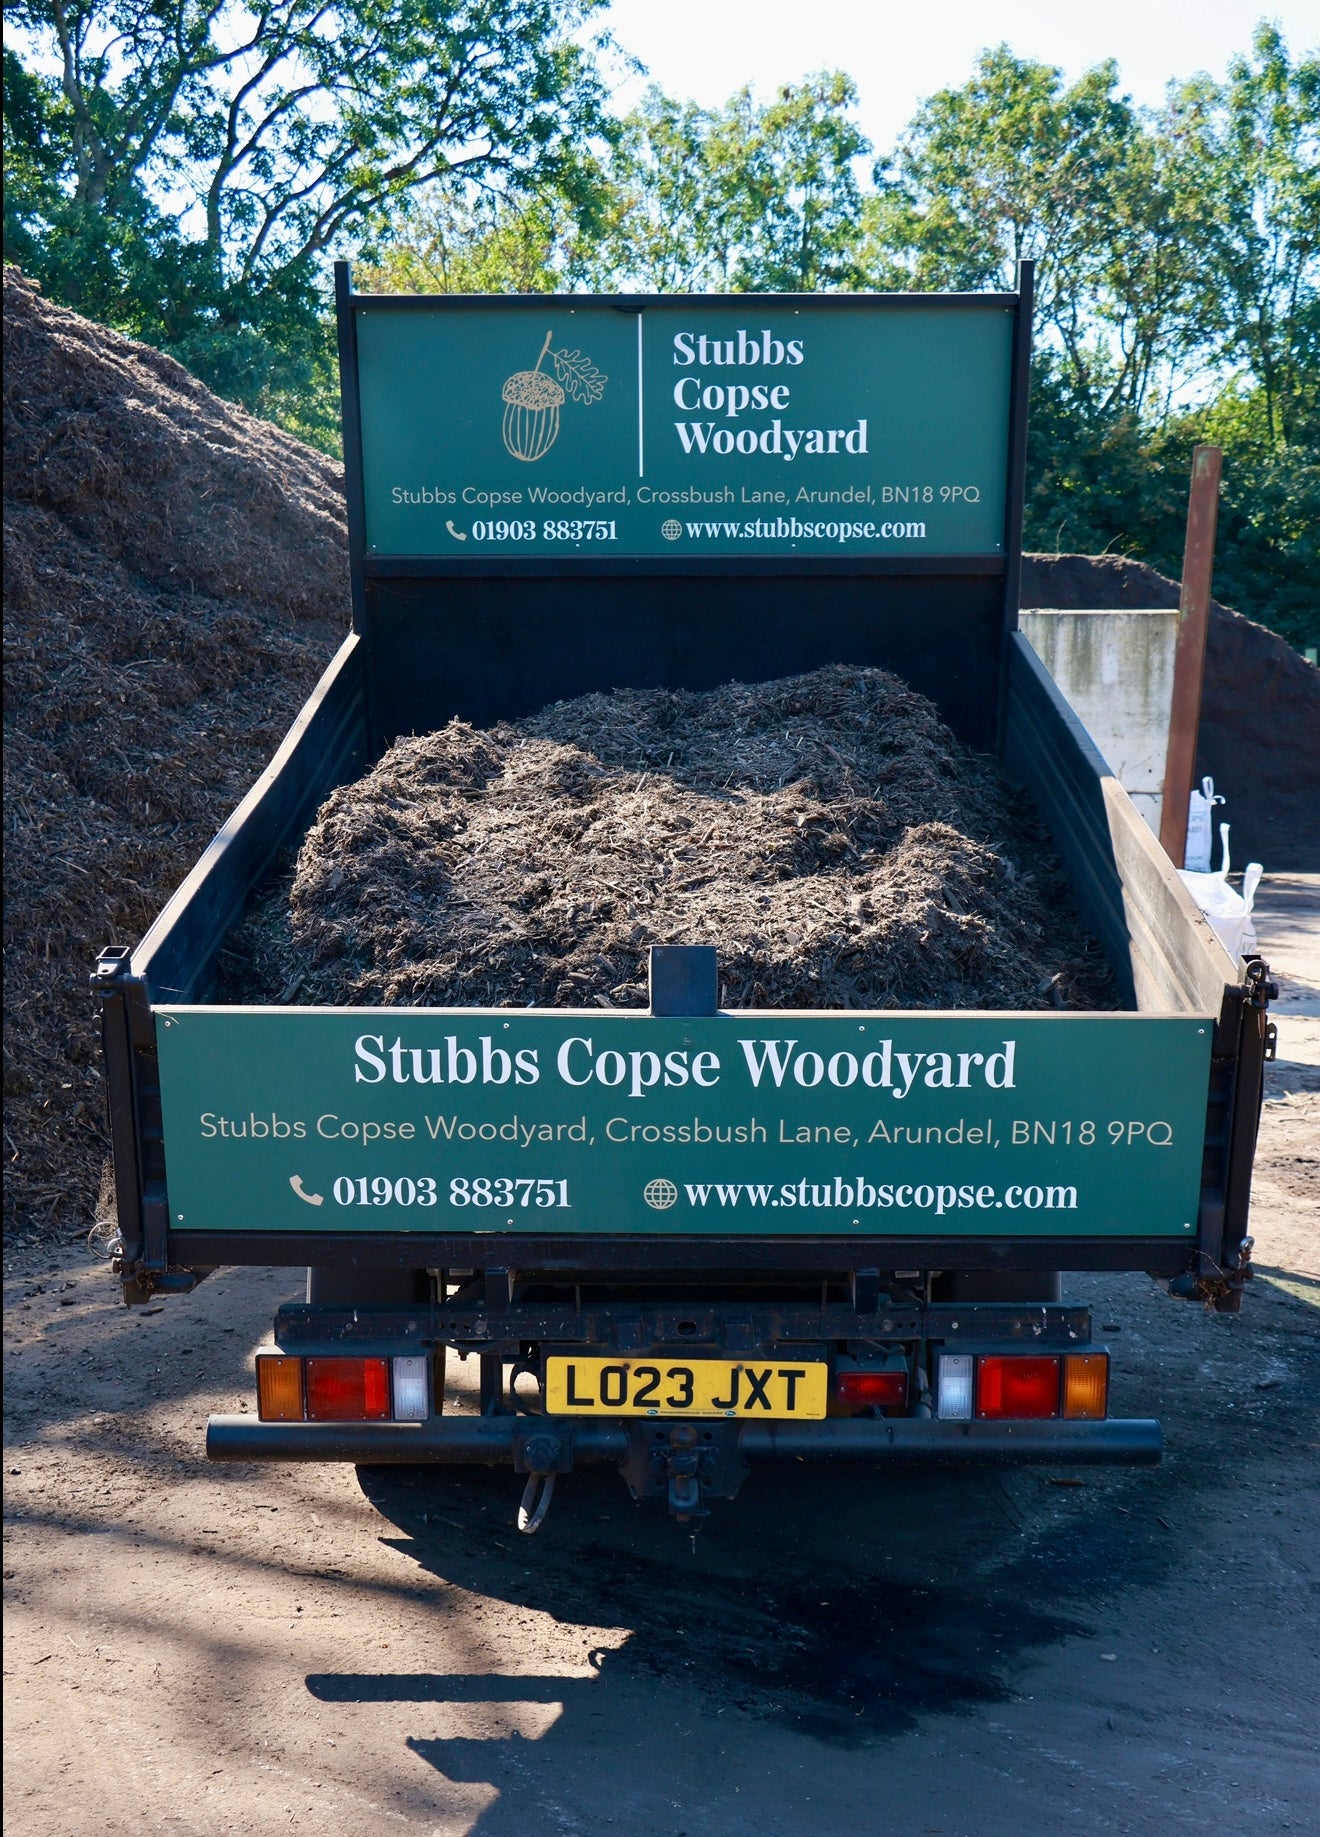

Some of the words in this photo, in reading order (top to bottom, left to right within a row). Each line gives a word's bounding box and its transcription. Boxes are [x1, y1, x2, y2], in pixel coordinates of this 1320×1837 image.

[674, 330, 804, 366] Stubbs
[674, 377, 790, 418] Copse
[675, 419, 869, 462] Woodyard
[391, 486, 457, 504] Stubbs
[463, 487, 522, 508] Copse
[527, 486, 631, 508] Woodyard,
[637, 485, 735, 504] Crossbush
[742, 486, 791, 506] Lane,
[795, 485, 875, 506] Arundel,
[881, 485, 934, 504] BN18
[940, 485, 981, 504] 9PQ
[472, 520, 537, 541] 01903
[543, 520, 618, 541] 883751
[686, 516, 926, 544] www.stubbscopse.com
[354, 1033, 540, 1085] Stubbs
[557, 1037, 721, 1097] Copse
[737, 1038, 1017, 1099] Woodyard
[200, 1112, 307, 1139] Stubbs
[316, 1113, 416, 1146] Copse
[425, 1114, 595, 1148] Woodyard,
[605, 1117, 767, 1144] Crossbush
[779, 1119, 859, 1148] Lane,
[868, 1119, 1000, 1149] Arundel,
[1011, 1120, 1096, 1146] BN18
[1107, 1120, 1173, 1146] 9PQ
[333, 1176, 438, 1207] 01903
[449, 1177, 572, 1208] 883751
[684, 1176, 1079, 1214] www.stubbscopse.com
[566, 1364, 694, 1408] LO23
[711, 1367, 806, 1411] JXT
